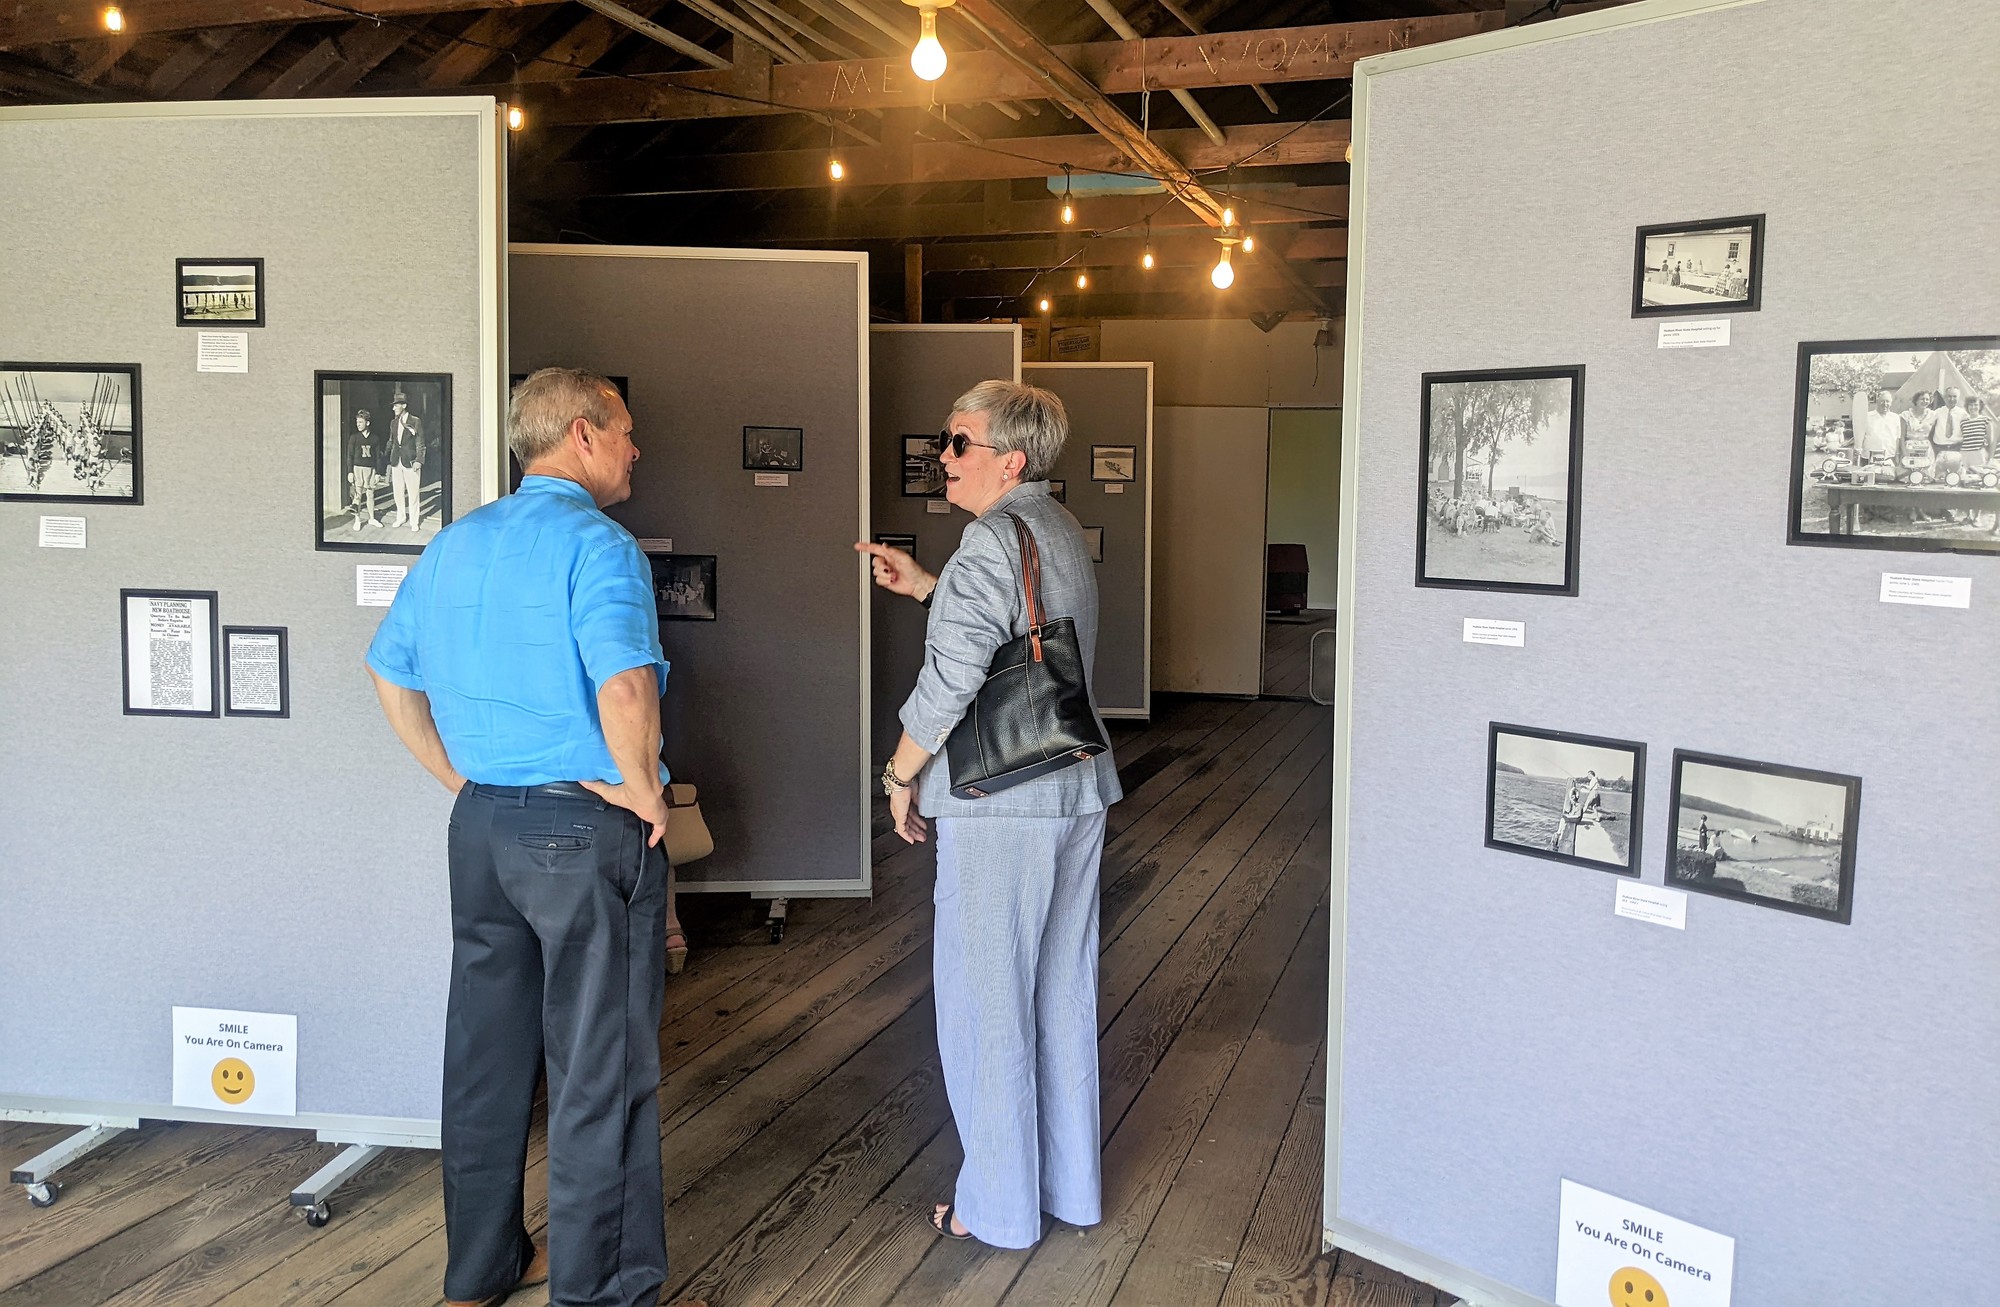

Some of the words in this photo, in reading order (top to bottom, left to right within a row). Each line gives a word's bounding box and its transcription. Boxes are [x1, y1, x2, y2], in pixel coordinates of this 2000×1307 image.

[361, 445, 372, 458] N
[218, 1023, 249, 1034] SMILE
[184, 1035, 204, 1046] You
[206, 1037, 224, 1047] Are
[226, 1038, 241, 1048] On
[243, 1040, 284, 1052] Camera
[1622, 1218, 1664, 1244] SMILE
[1575, 1220, 1601, 1240] You
[1604, 1232, 1628, 1250] Are
[1631, 1242, 1651, 1260] On
[1655, 1251, 1712, 1282] Camera
